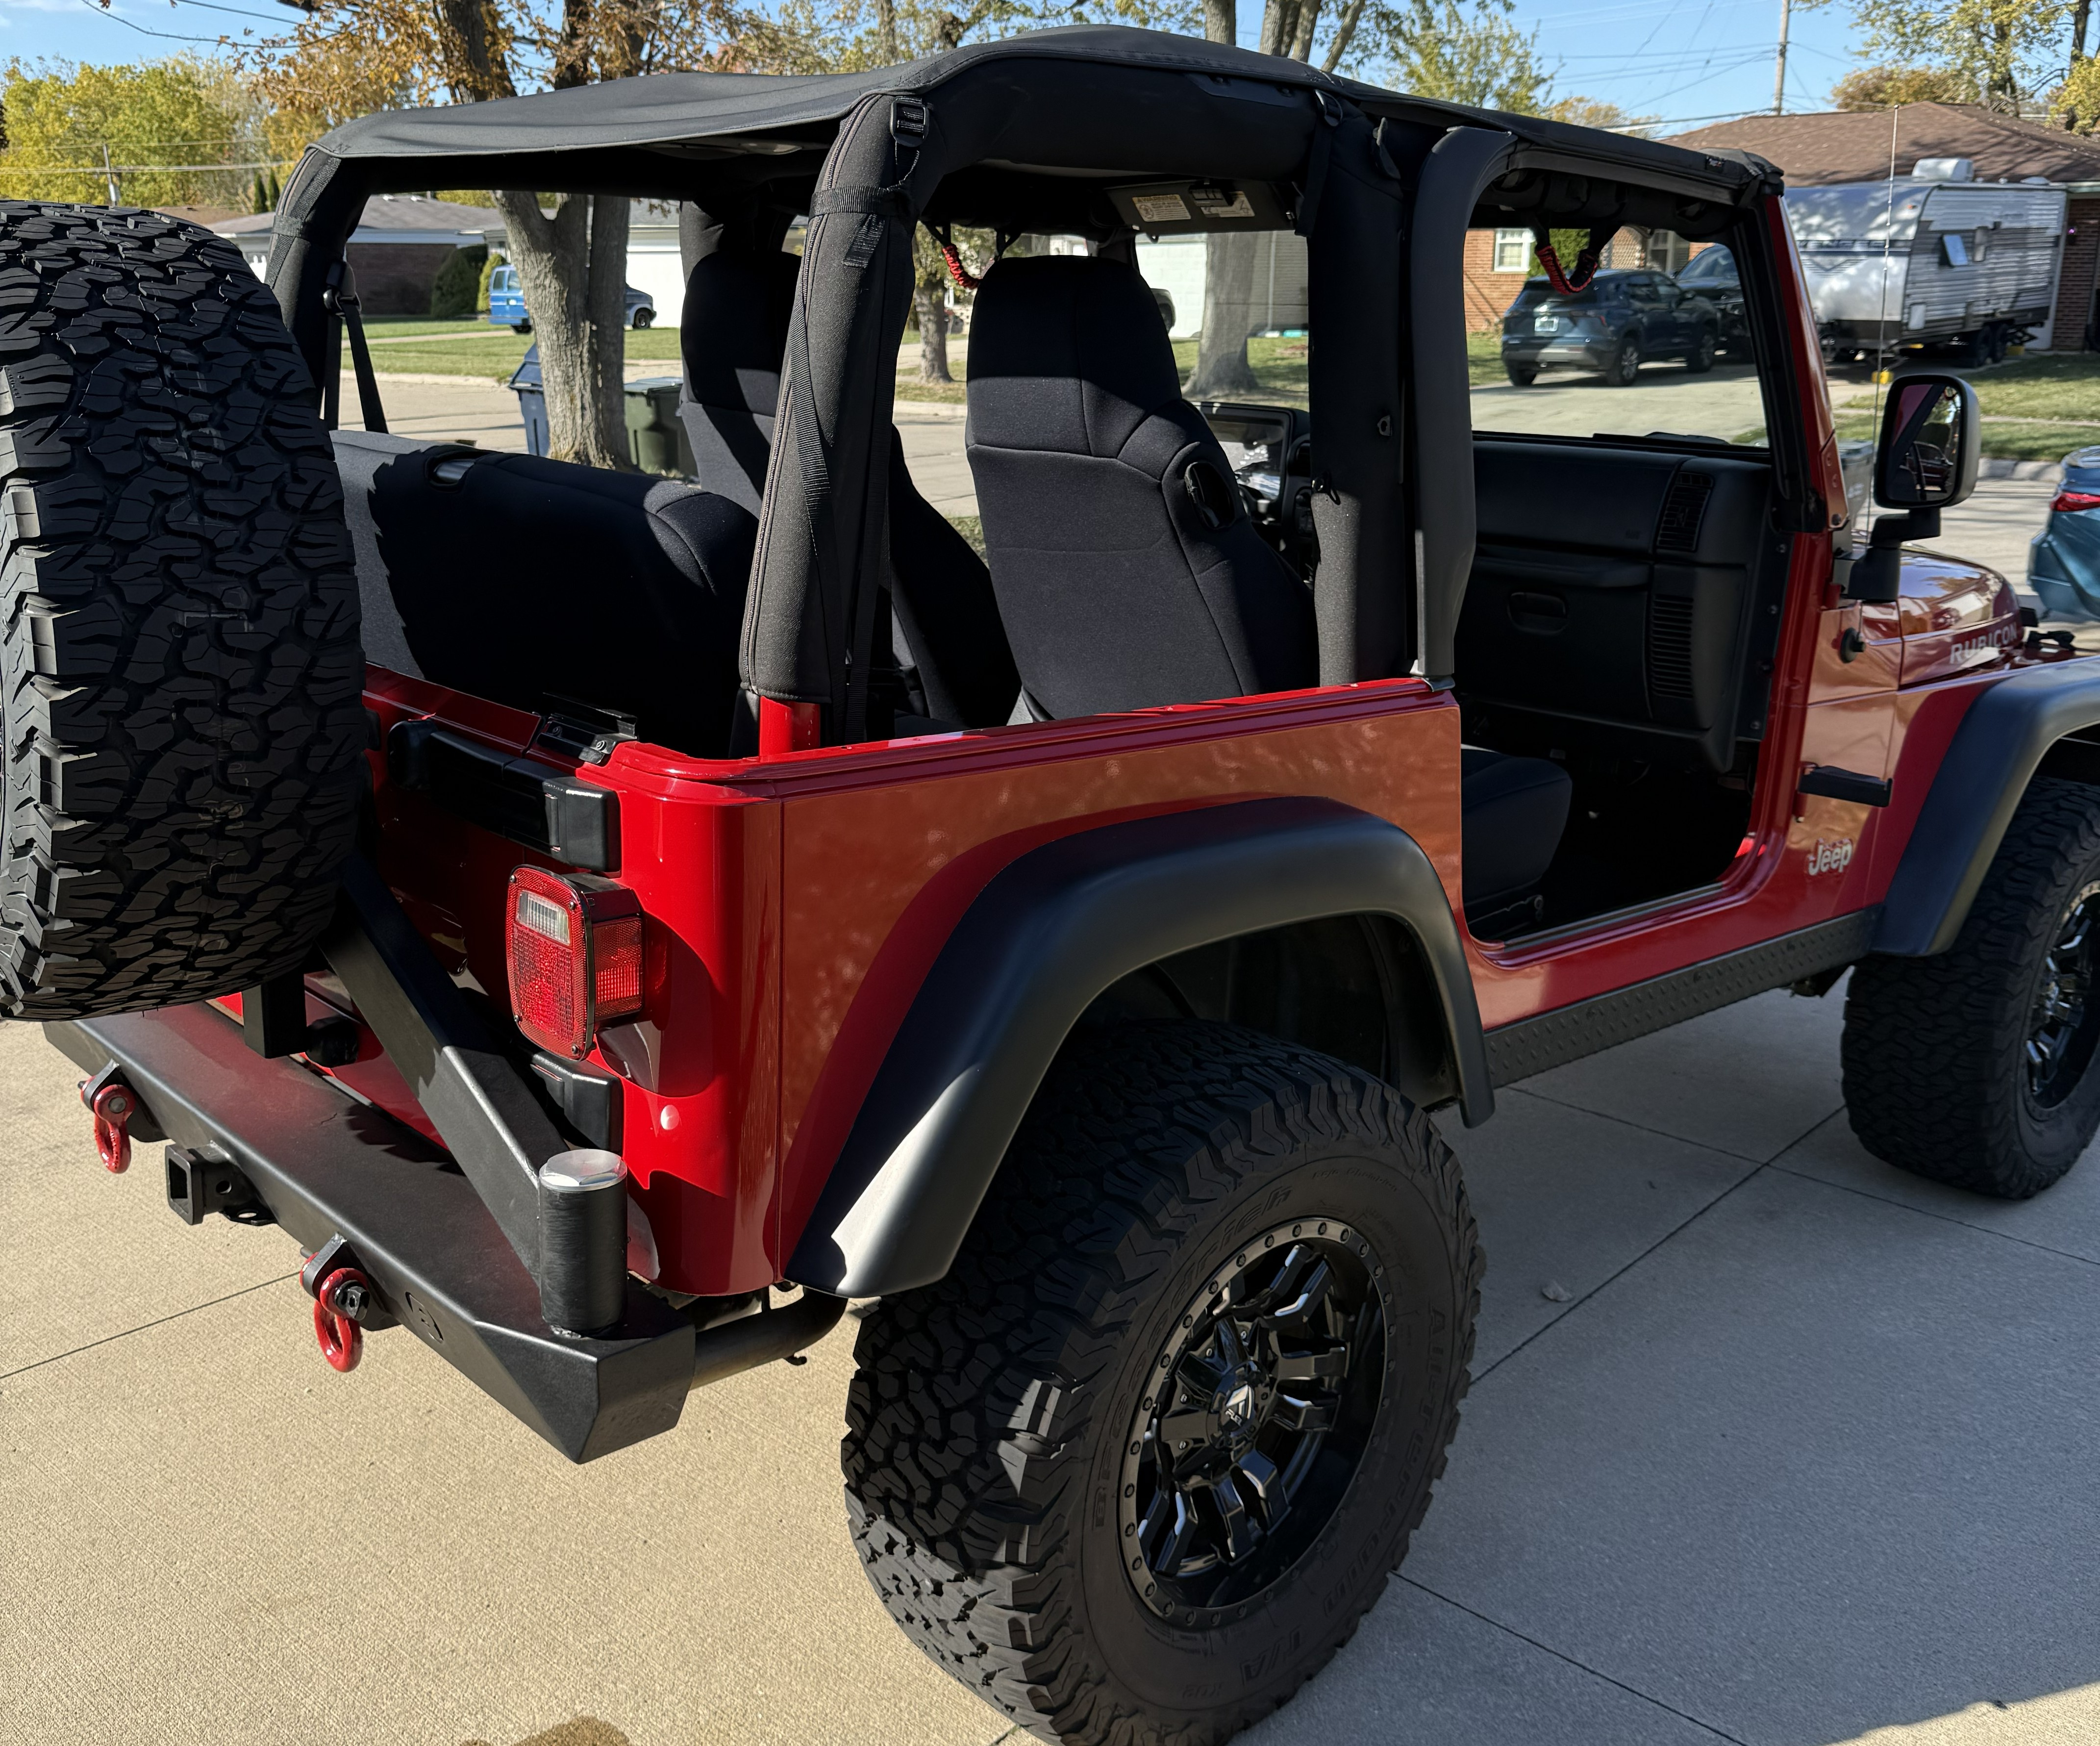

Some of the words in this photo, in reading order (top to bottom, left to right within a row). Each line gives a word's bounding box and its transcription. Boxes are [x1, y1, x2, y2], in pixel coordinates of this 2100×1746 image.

[1950, 622, 2018, 664] RUBICON
[1808, 841, 1852, 876] Jeep
[1225, 1408, 1243, 1426] FUEL
